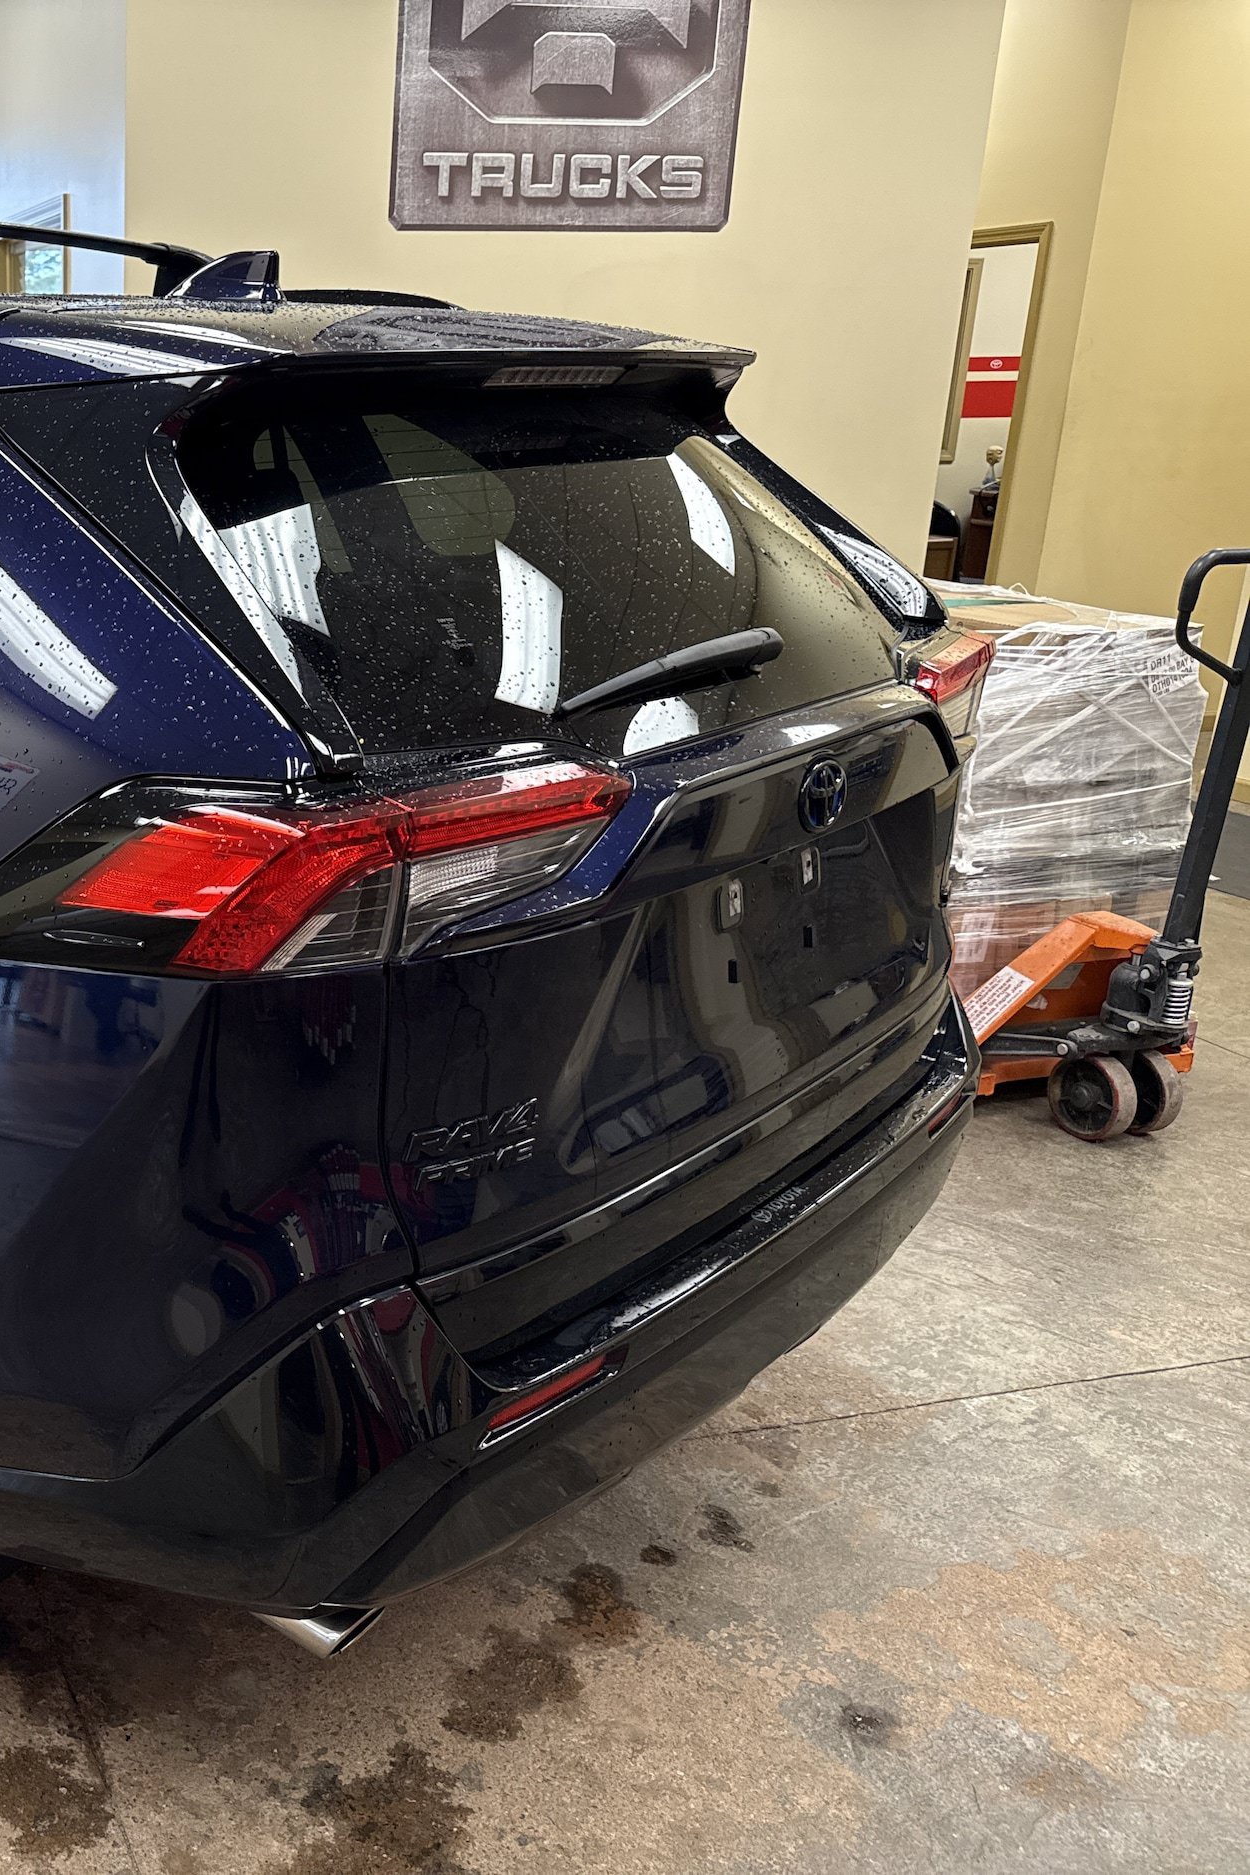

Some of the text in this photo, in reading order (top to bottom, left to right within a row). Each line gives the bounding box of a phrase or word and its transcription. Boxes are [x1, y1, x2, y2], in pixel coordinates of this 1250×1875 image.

[422, 152, 704, 199] TRUCKS
[404, 1097, 539, 1163] RAV4
[415, 1137, 536, 1191] PRIME
[767, 1186, 807, 1212] TOYOTA
